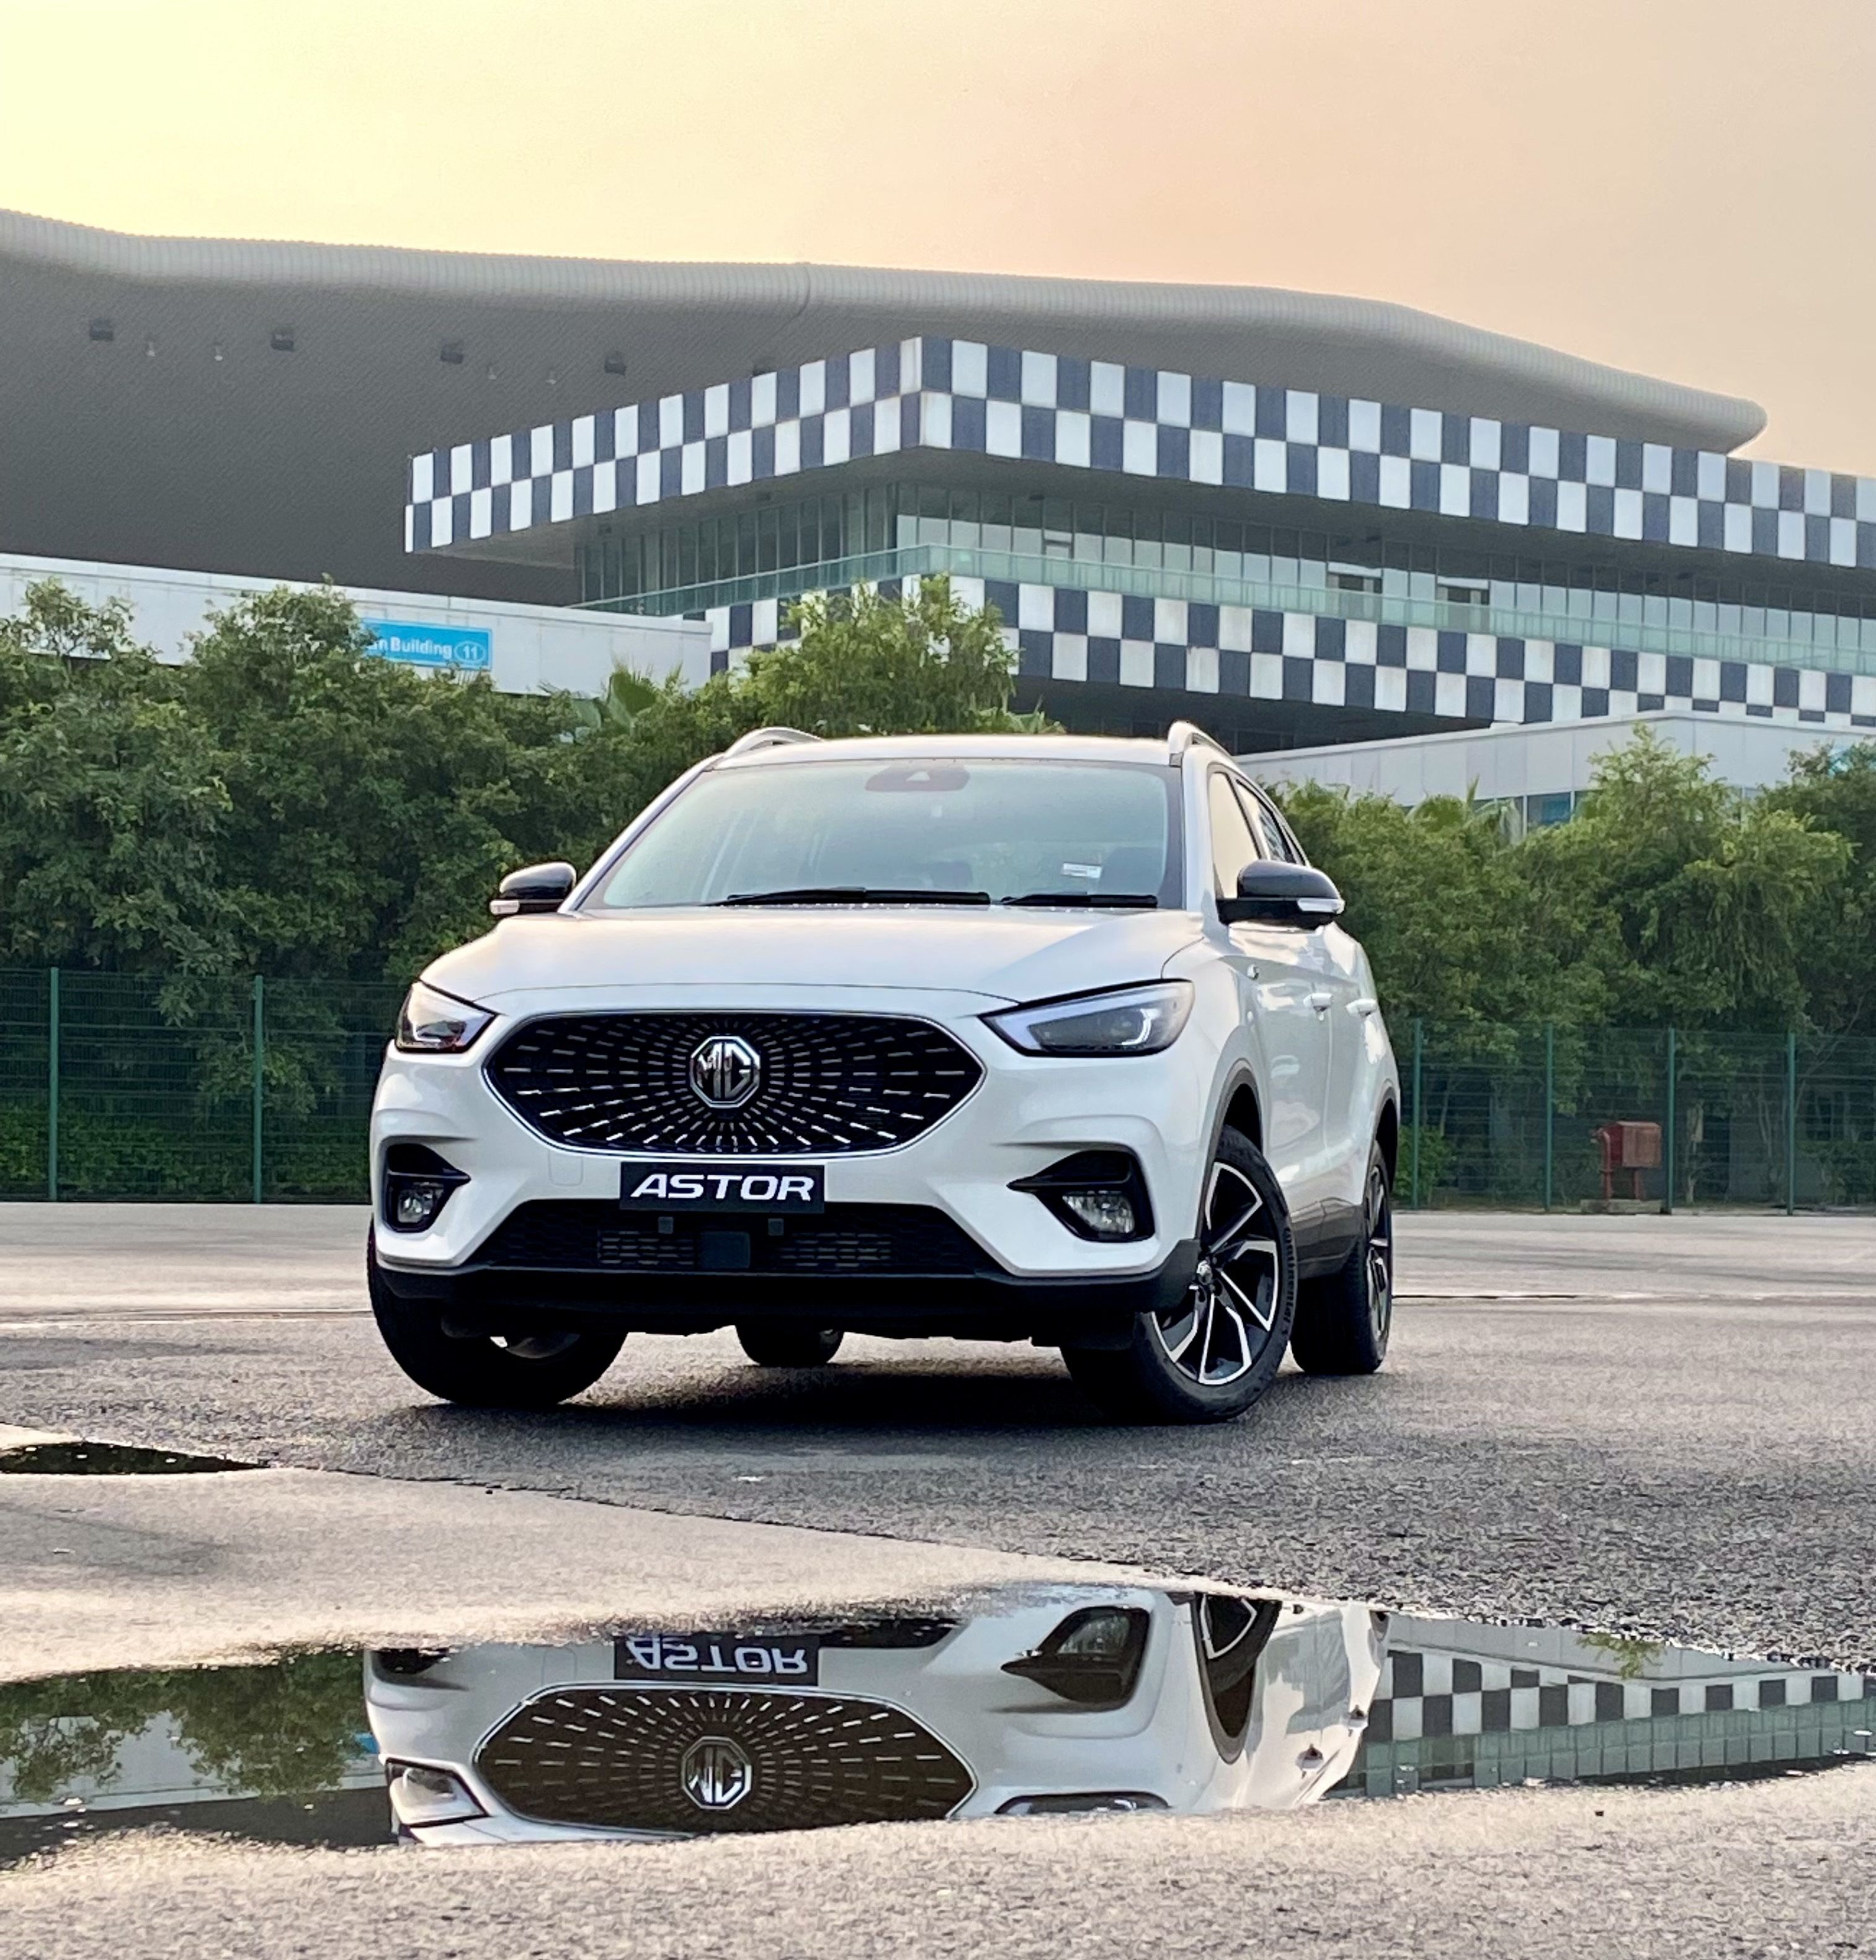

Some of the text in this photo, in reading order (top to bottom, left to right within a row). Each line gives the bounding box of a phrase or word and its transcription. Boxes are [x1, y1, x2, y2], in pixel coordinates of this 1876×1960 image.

[390, 636, 453, 659] Building
[463, 646, 478, 660] 11
[696, 1042, 751, 1098] MG
[630, 1174, 814, 1200] ASTOR
